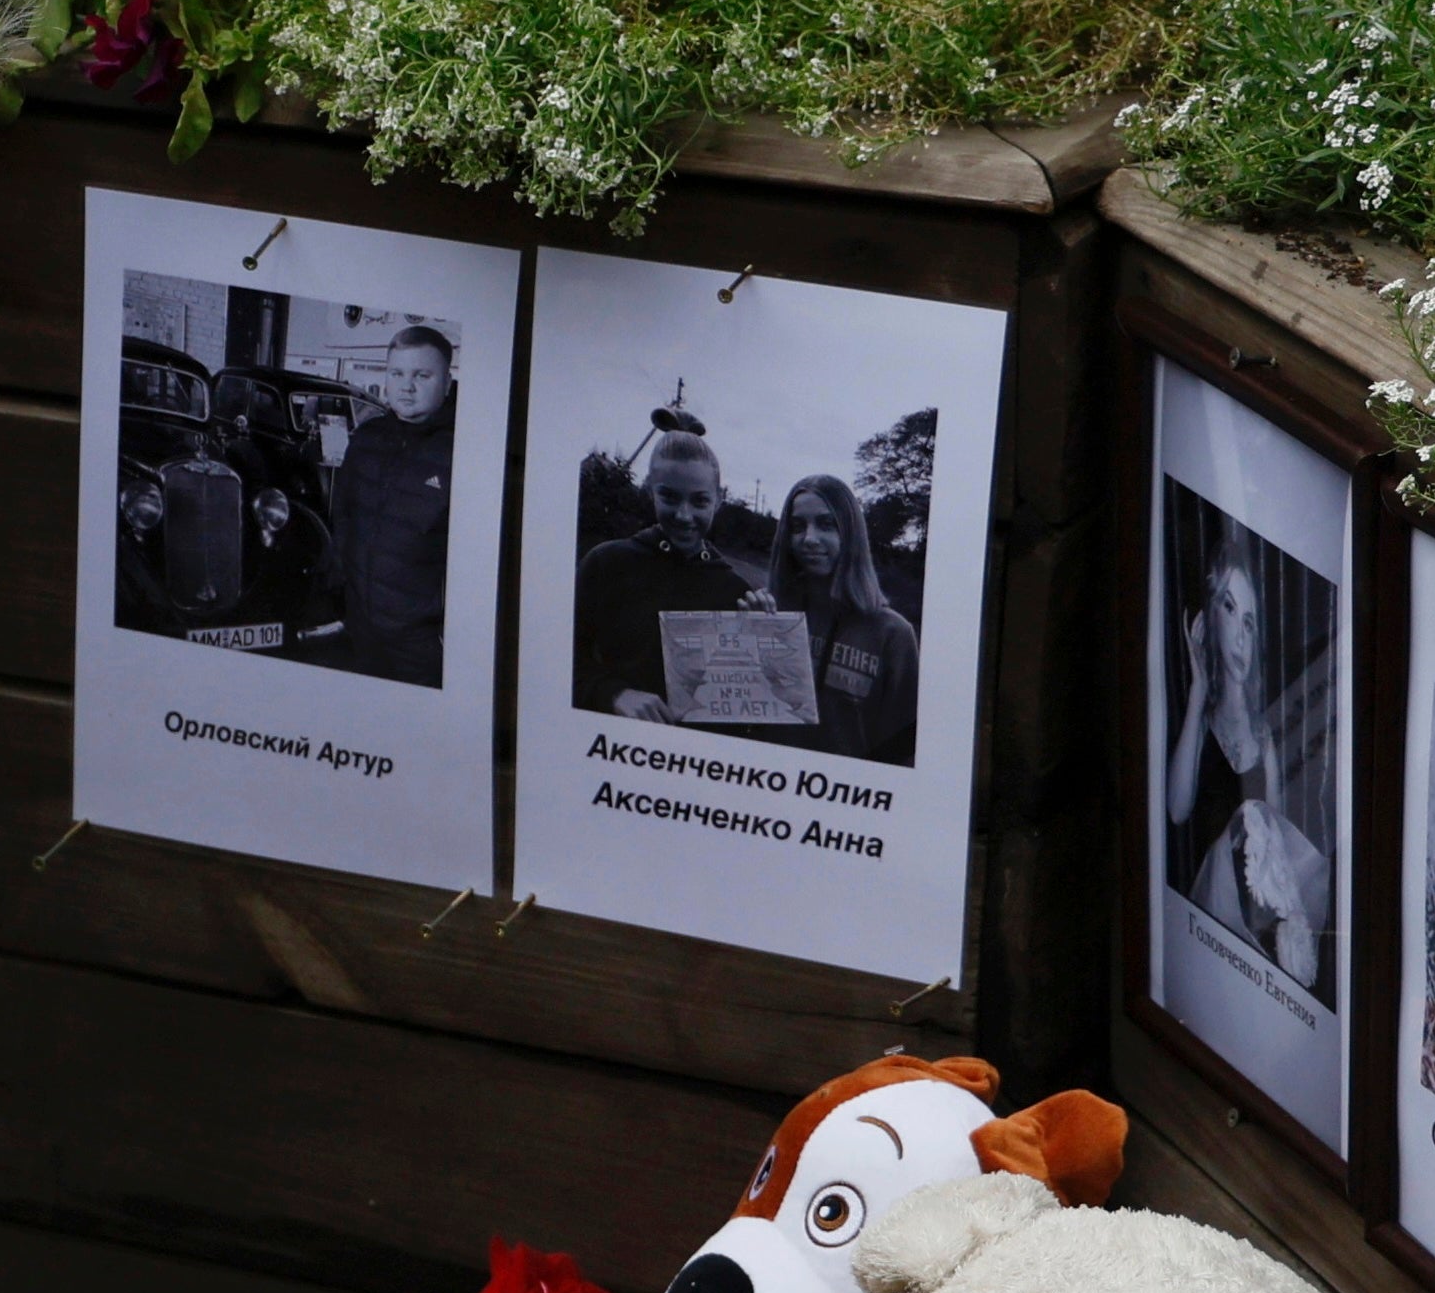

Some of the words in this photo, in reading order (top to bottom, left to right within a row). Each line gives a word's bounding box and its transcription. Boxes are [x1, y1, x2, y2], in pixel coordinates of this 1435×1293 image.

[259, 625, 281, 645] 101
[163, 709, 311, 762] Орловский
[316, 740, 395, 779] Артур
[586, 731, 789, 794] Аксенченко
[794, 771, 894, 813] Юлия
[590, 780, 795, 841] Аксенченко
[798, 818, 885, 859] Анна
[1188, 912, 1262, 987] Головченко
[1264, 969, 1318, 1031] Евгения
